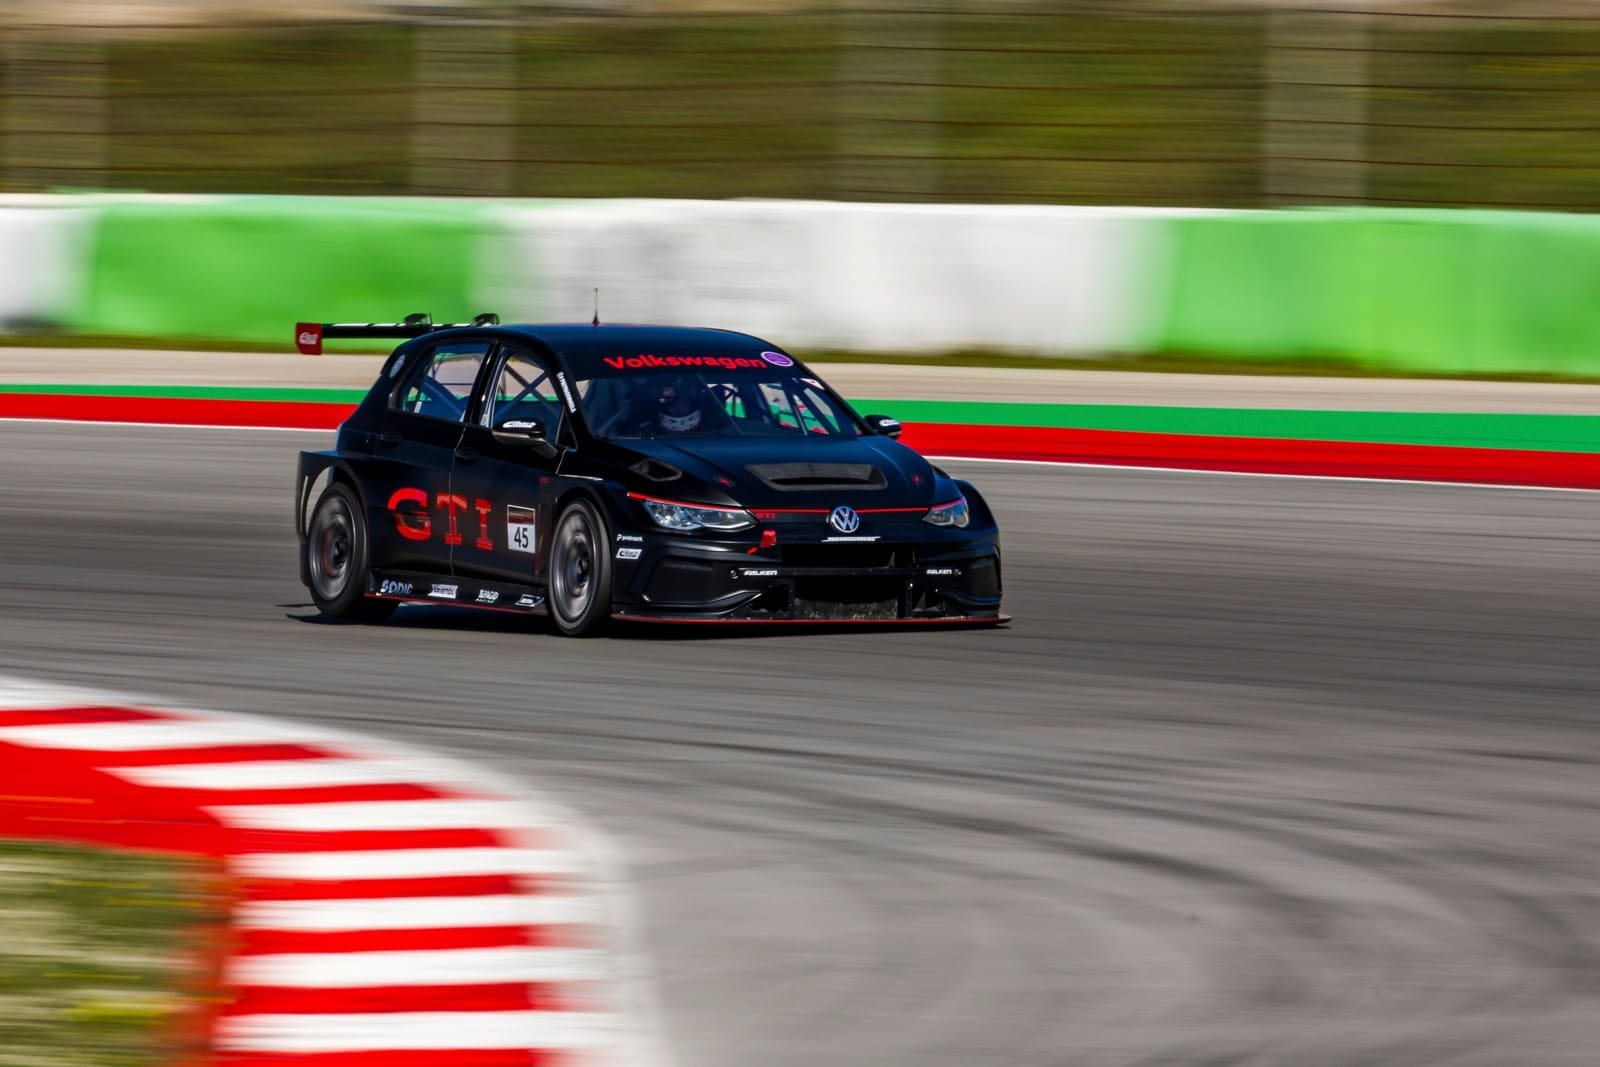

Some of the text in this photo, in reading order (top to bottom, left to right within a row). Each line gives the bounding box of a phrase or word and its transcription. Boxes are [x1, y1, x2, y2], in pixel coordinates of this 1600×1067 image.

[603, 354, 768, 369] Volkswagen
[387, 487, 493, 551] GTI
[513, 526, 529, 549] 45
